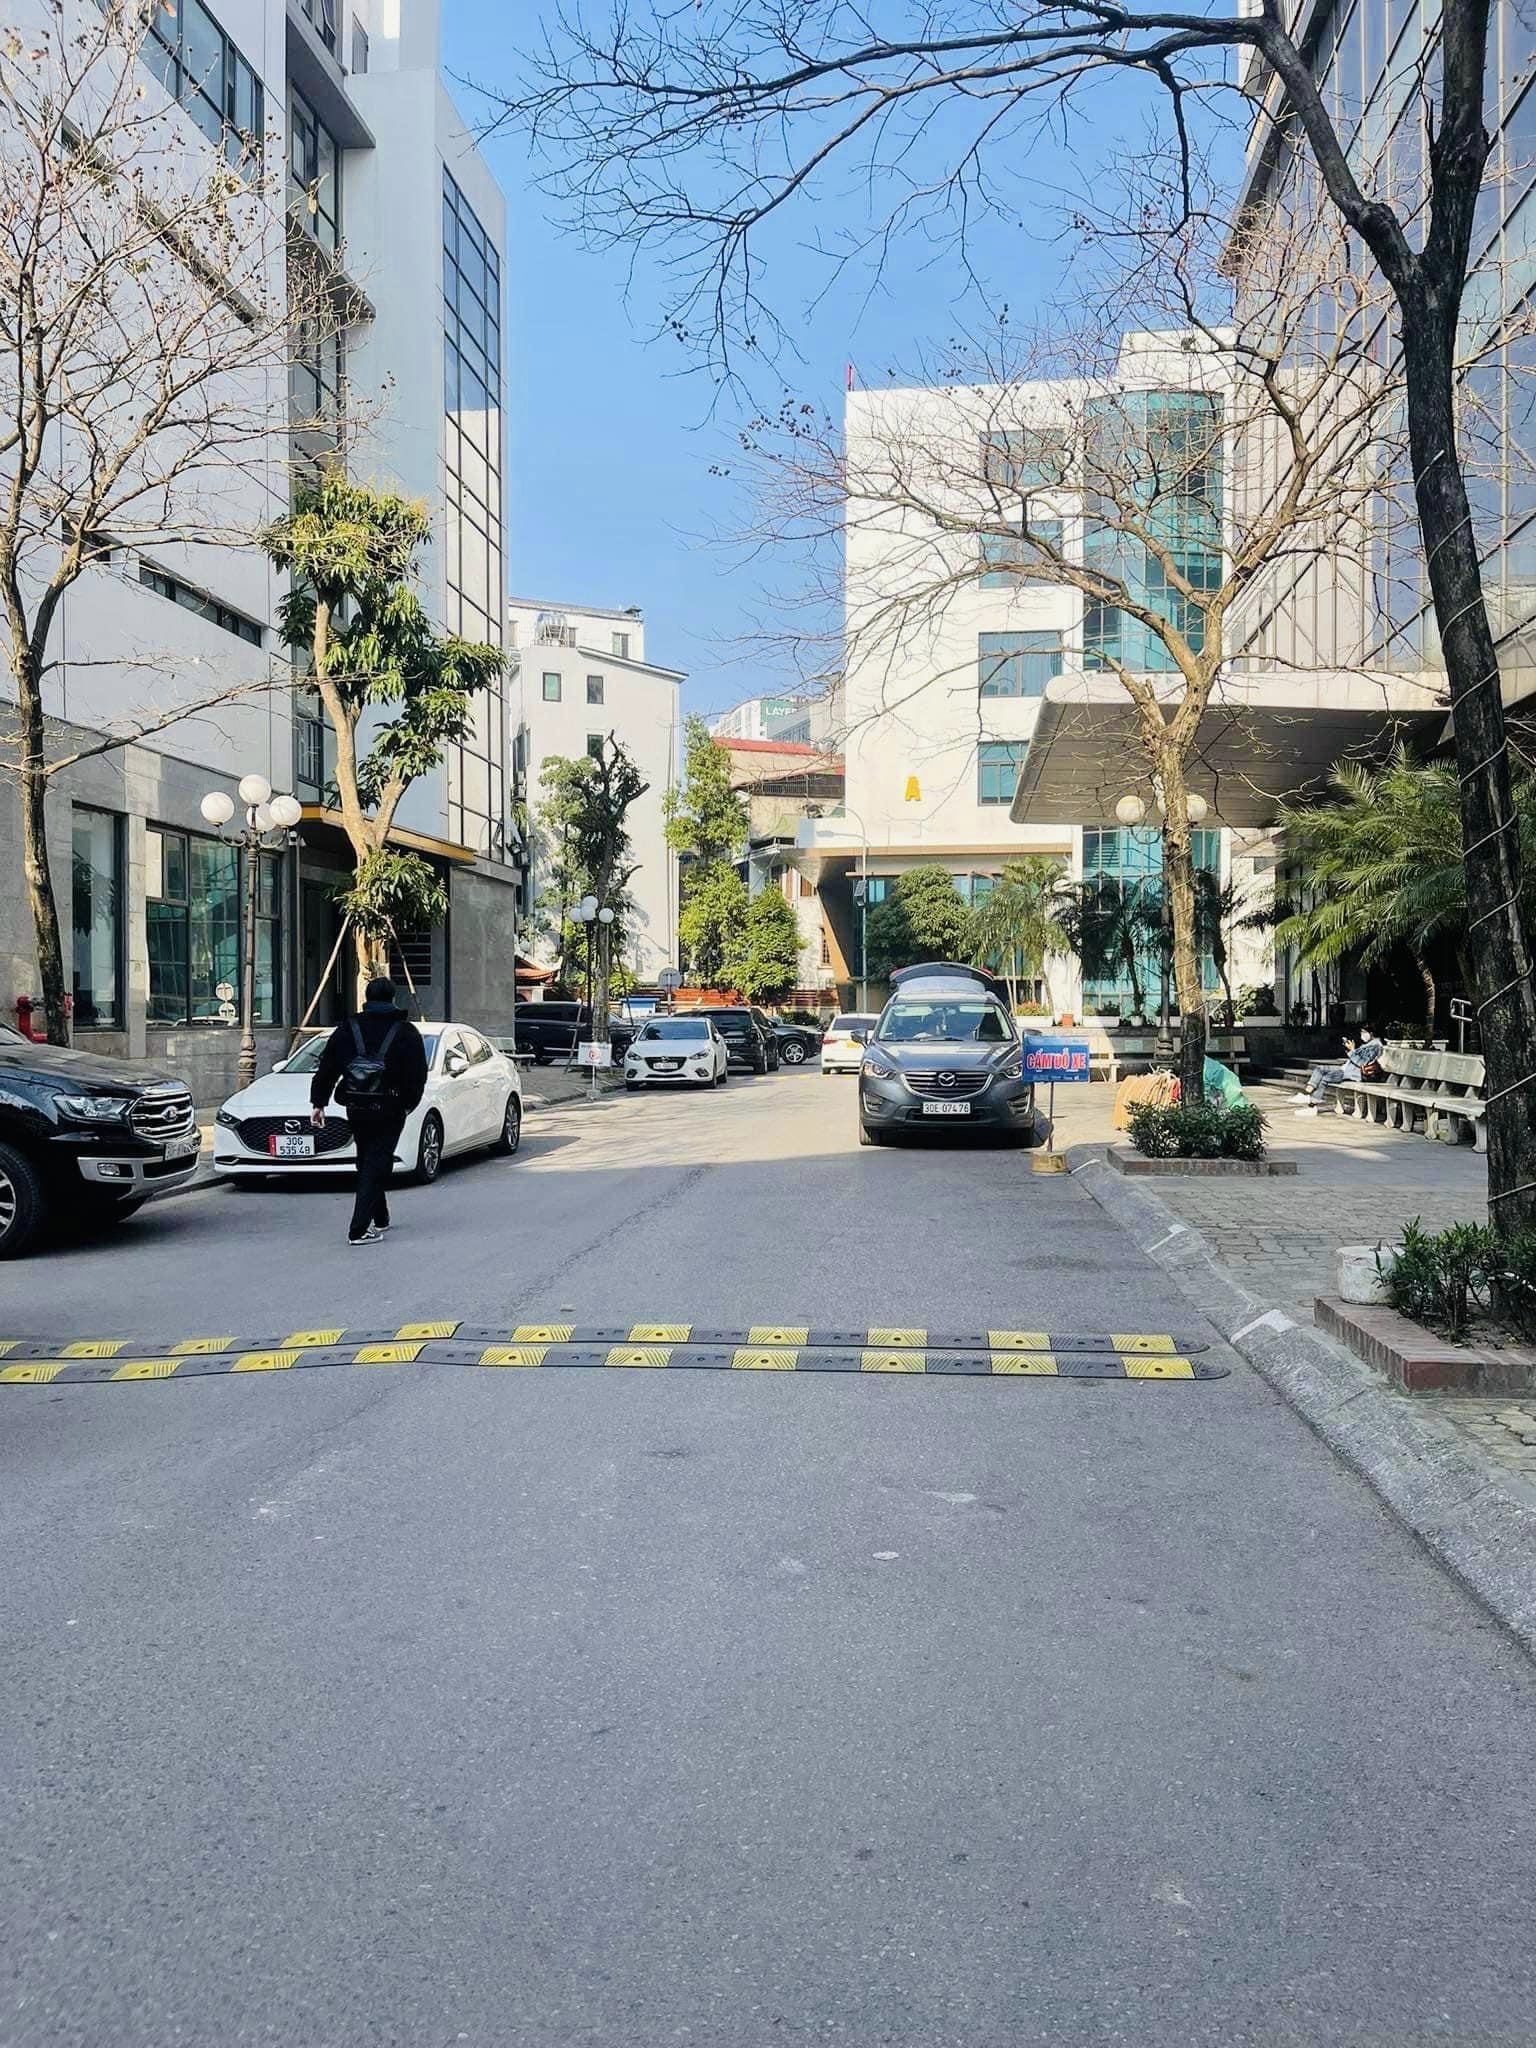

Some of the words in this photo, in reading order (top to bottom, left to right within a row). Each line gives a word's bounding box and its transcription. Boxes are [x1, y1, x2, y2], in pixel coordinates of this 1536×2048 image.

[904, 776, 921, 801] A
[1071, 1052, 1087, 1070] XE
[286, 1136, 304, 1146] 30G
